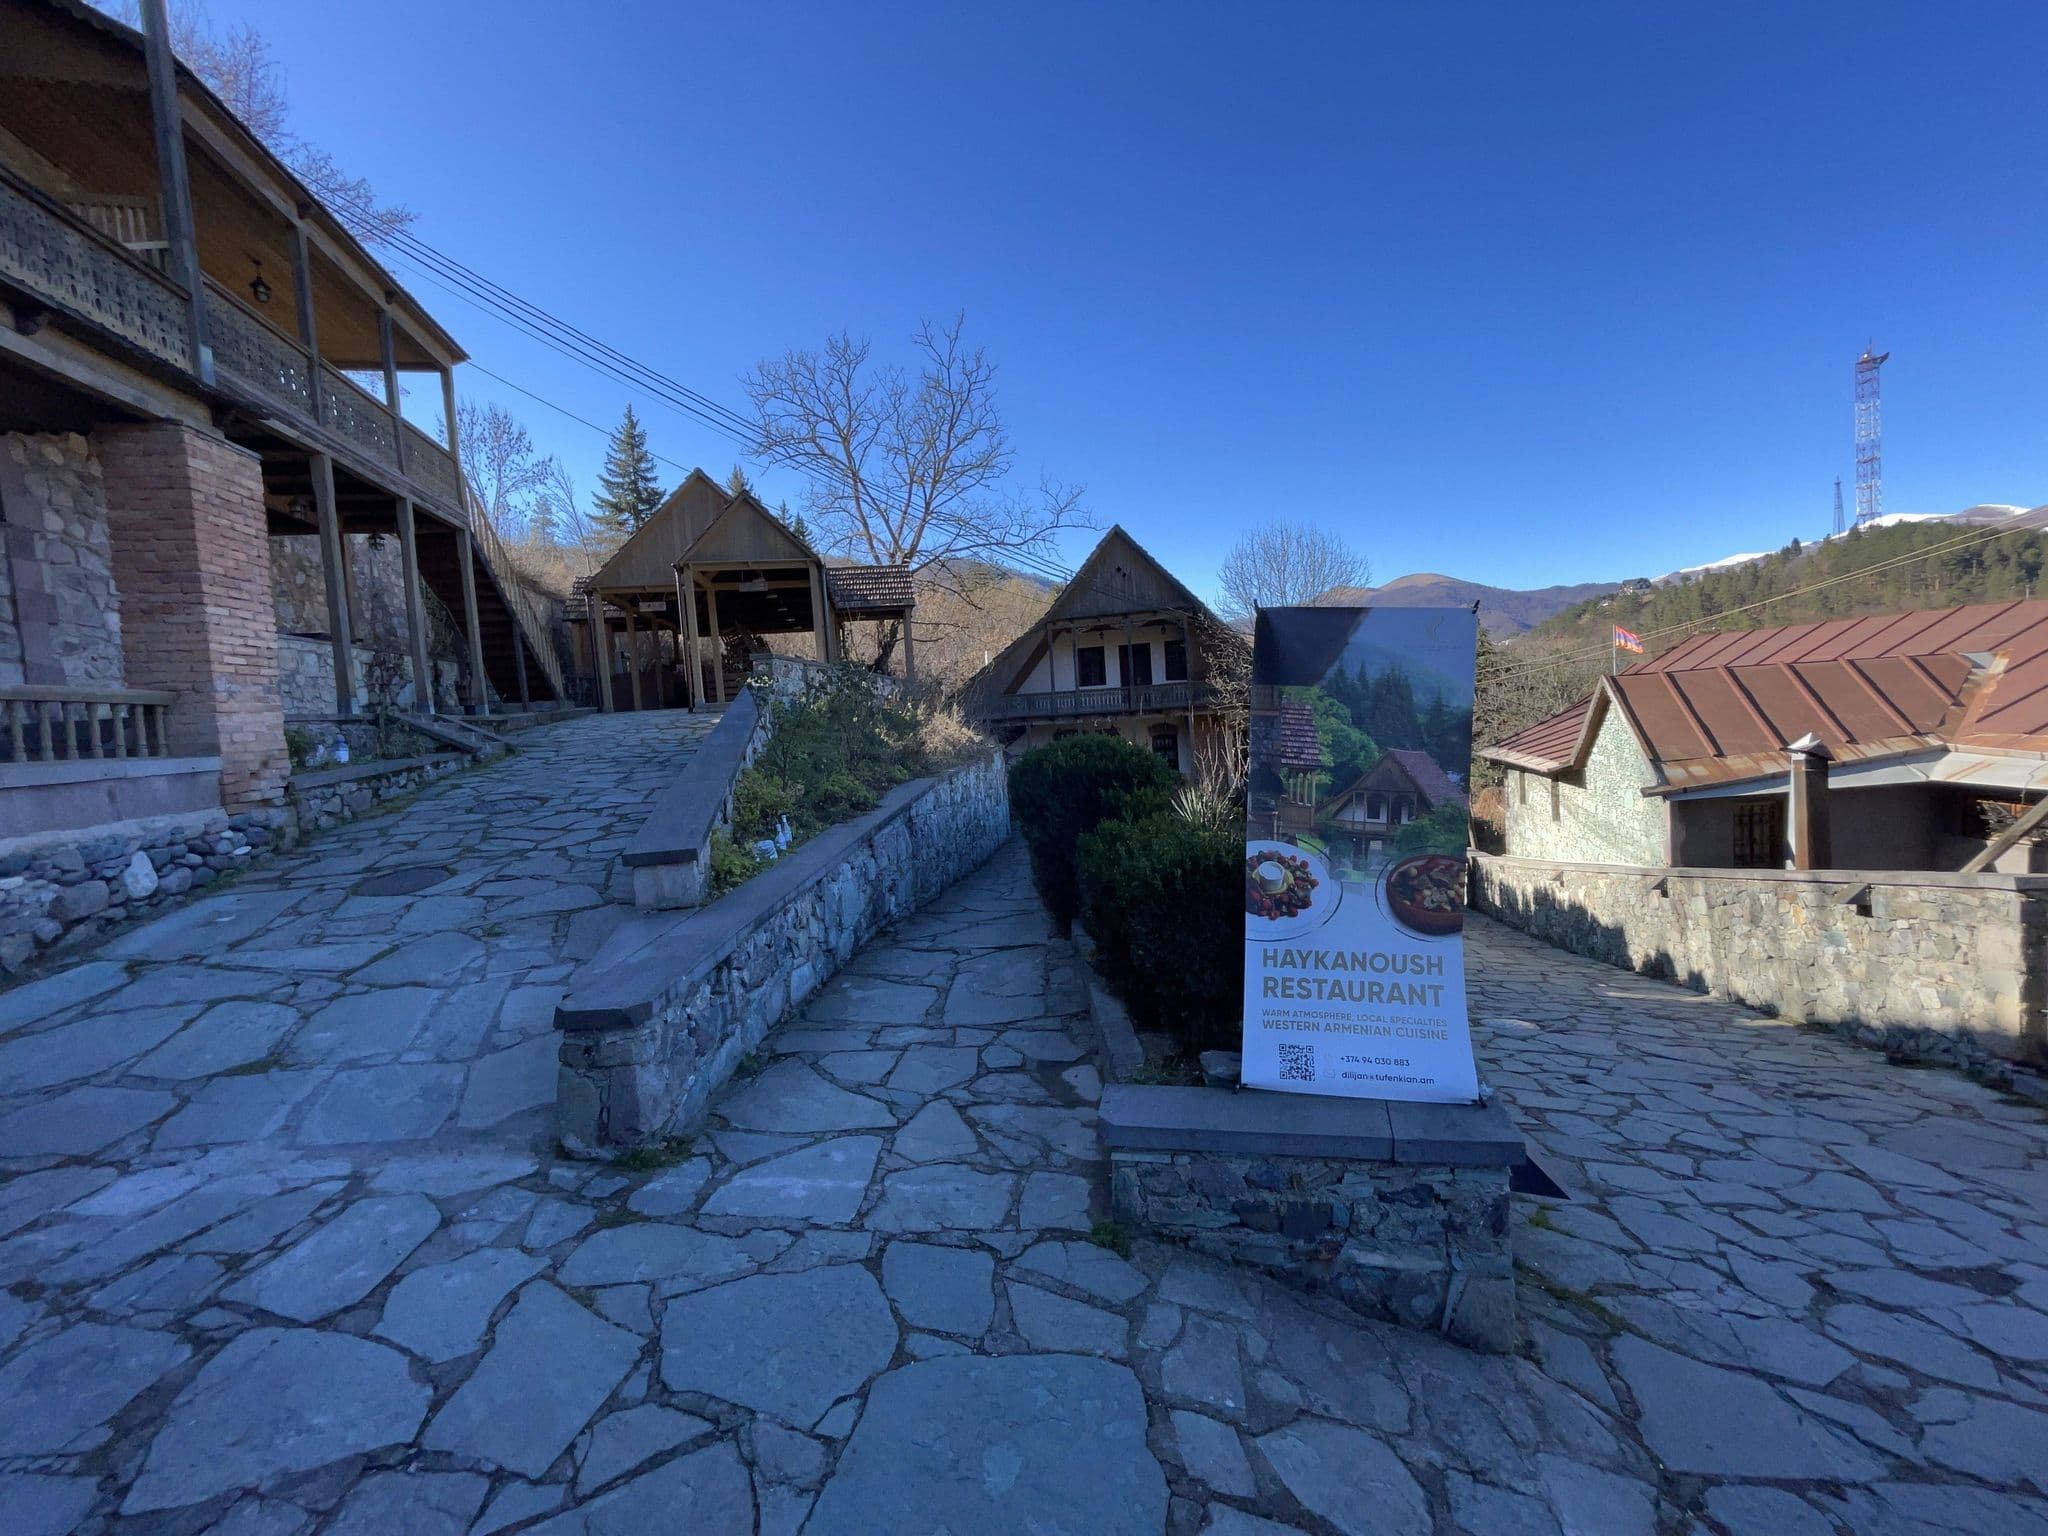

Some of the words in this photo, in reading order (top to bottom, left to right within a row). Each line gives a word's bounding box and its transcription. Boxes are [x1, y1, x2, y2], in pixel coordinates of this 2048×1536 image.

[1263, 948, 1443, 976] HAYKANOUSH
[1263, 977, 1444, 1007] RESTAURANT
[1262, 1008, 1290, 1018] WARM
[1357, 1014, 1388, 1024] LOCAL
[1390, 1016, 1448, 1027] SPECIALTIES
[1262, 1019, 1320, 1032] WESTERN
[1324, 1023, 1391, 1037] ARMENIAN
[1396, 1027, 1449, 1041] CUISINE
[1340, 1055, 1360, 1063] +374
[1361, 1056, 1373, 1065] 94
[1374, 1057, 1392, 1066] 030
